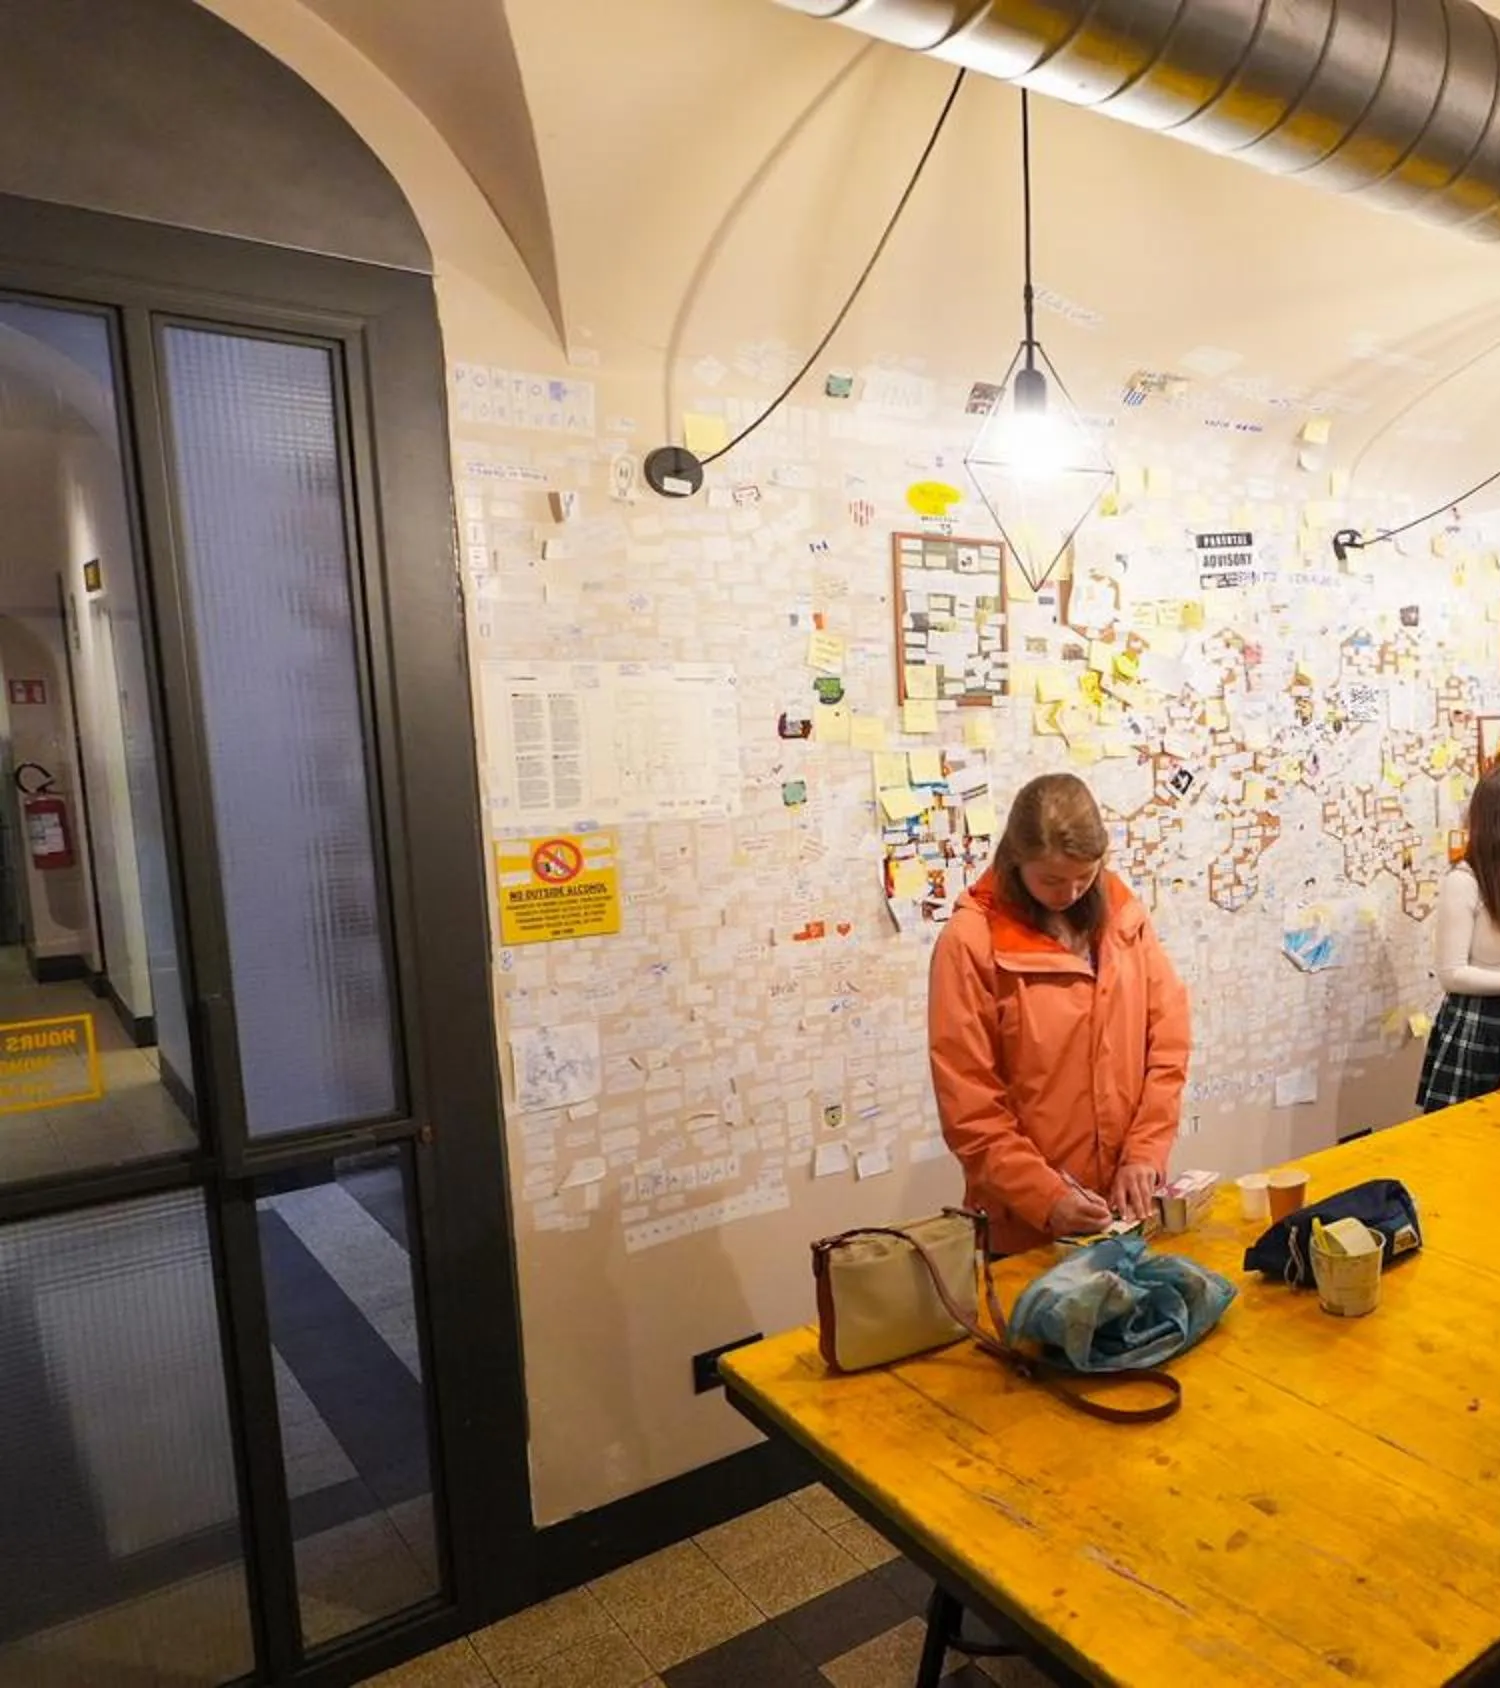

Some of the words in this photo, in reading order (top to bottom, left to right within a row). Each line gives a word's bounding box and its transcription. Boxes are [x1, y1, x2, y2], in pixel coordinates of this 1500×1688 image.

[1203, 535, 1247, 546] PARENTAL
[1203, 552, 1252, 568] ADVISORY
[509, 890, 523, 902] NO
[526, 887, 563, 900] OUTSIDE
[566, 882, 608, 897] ALCOHOL
